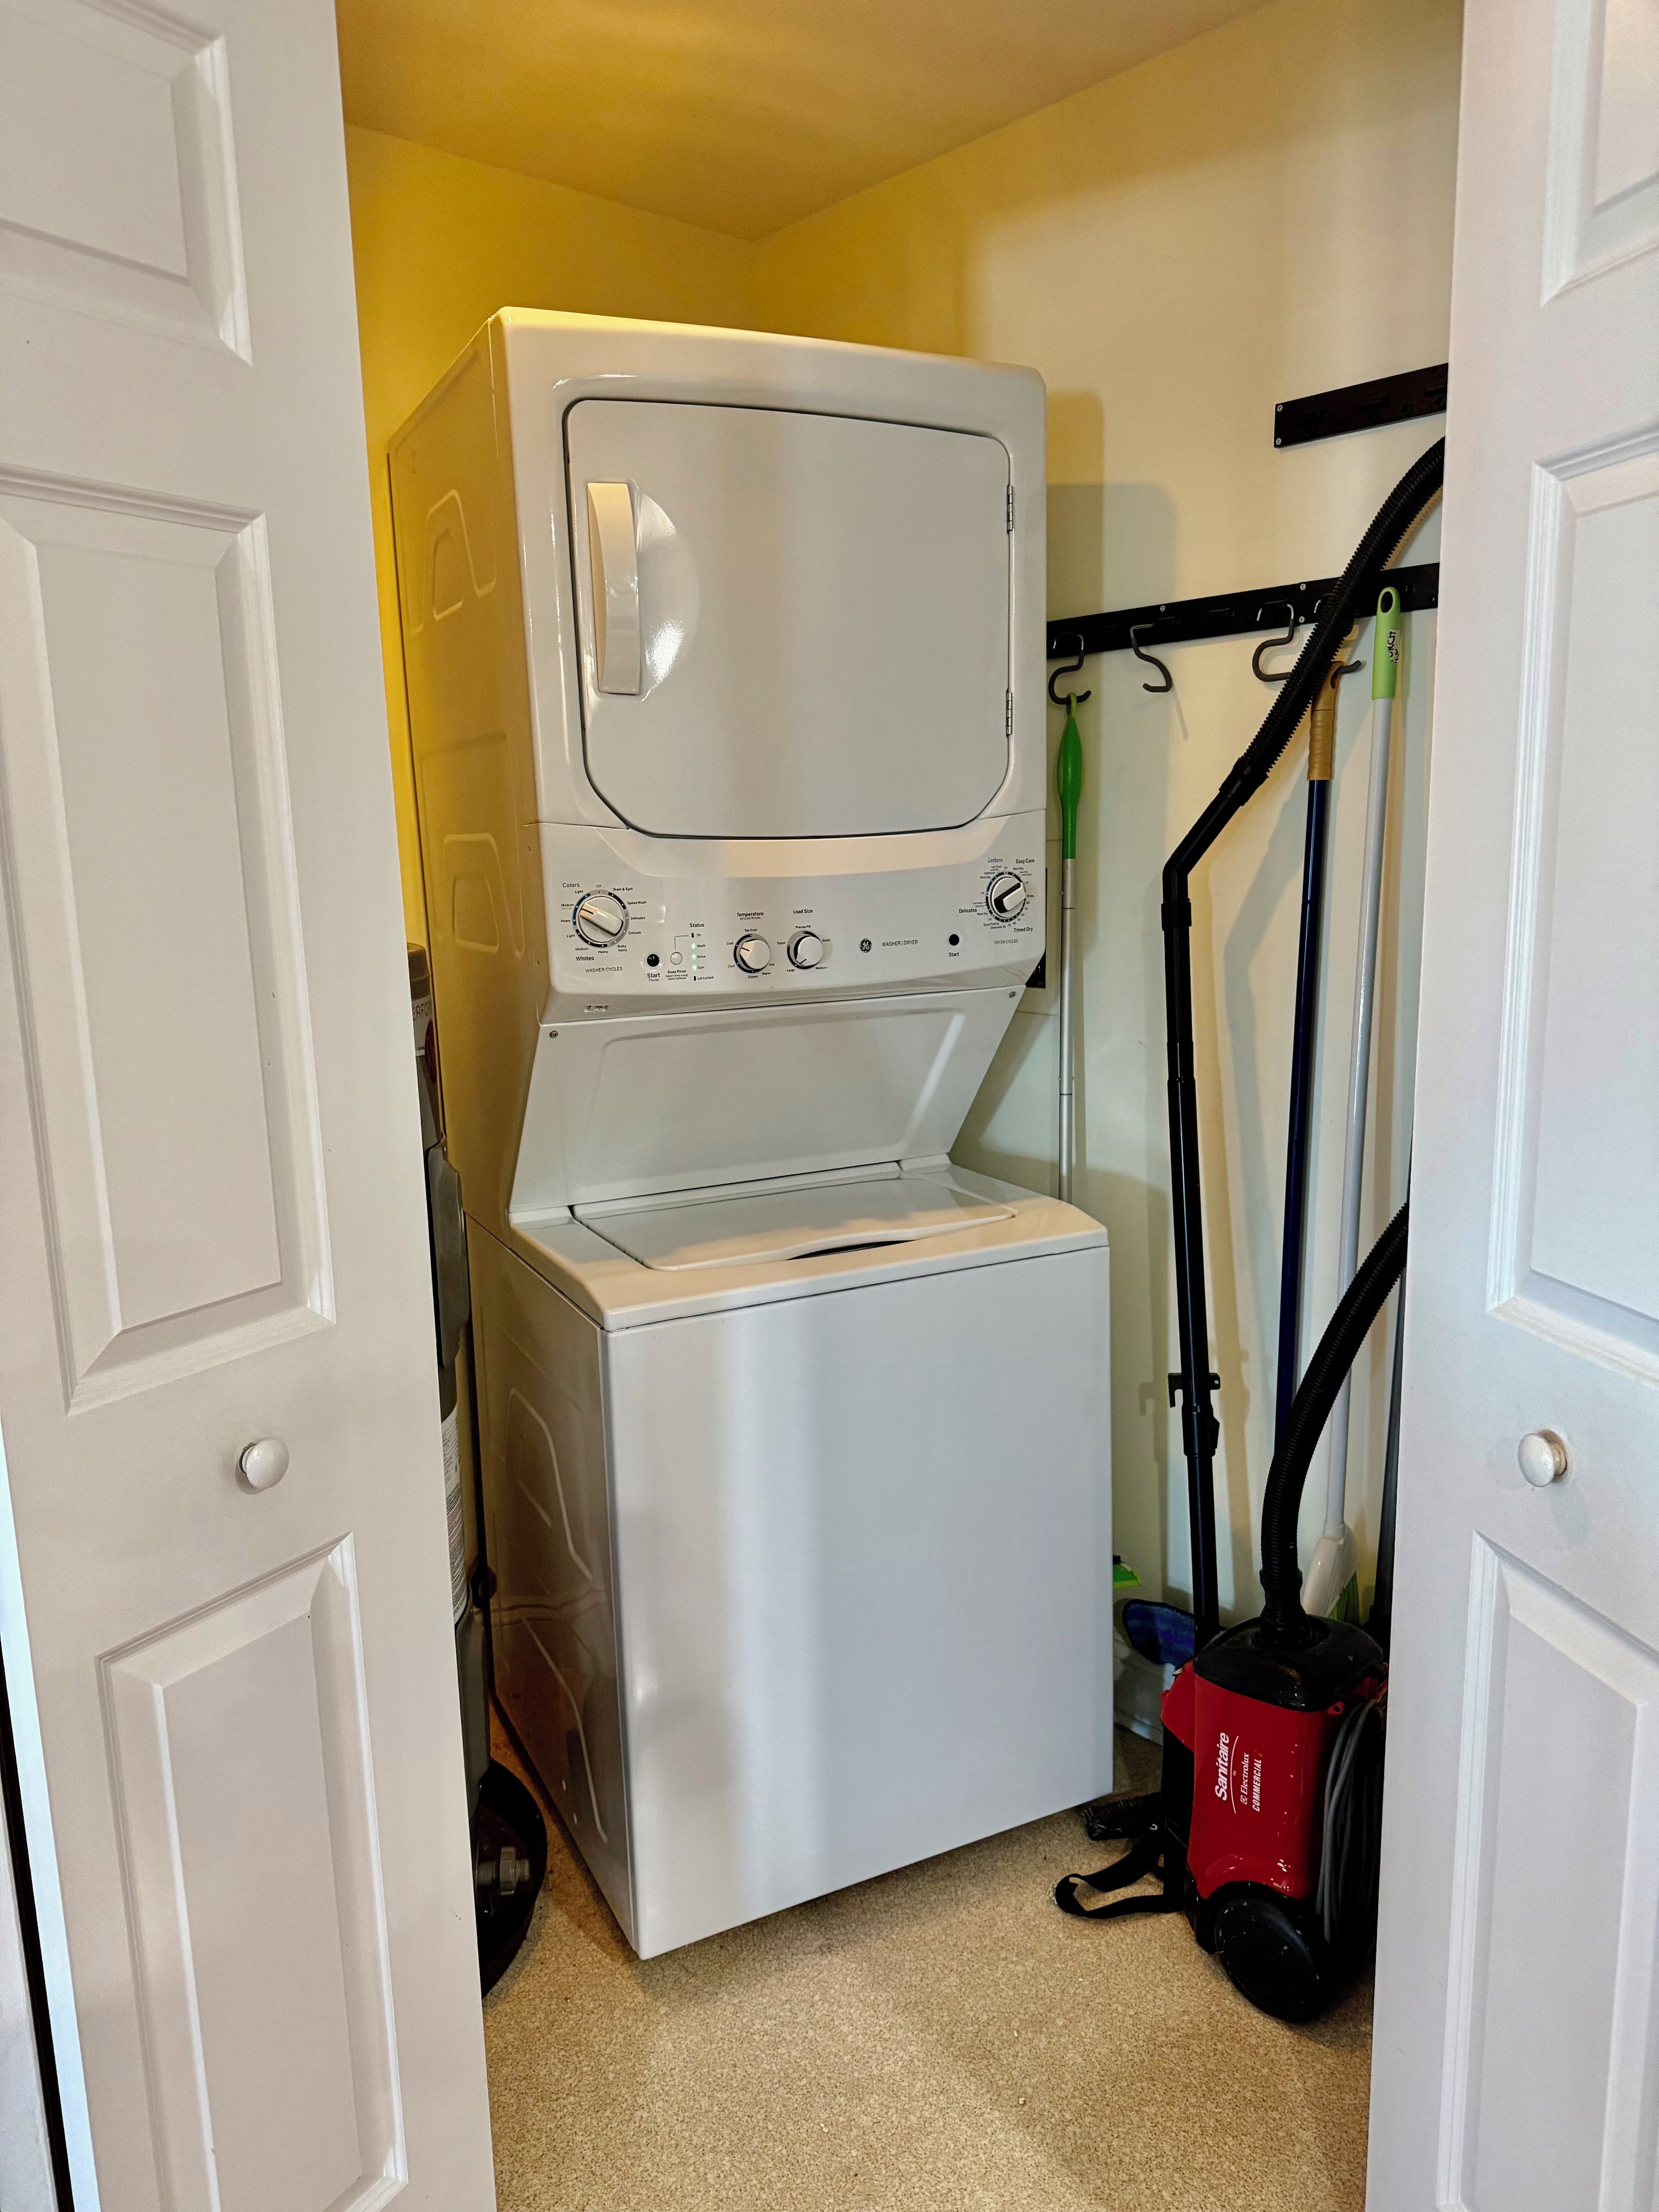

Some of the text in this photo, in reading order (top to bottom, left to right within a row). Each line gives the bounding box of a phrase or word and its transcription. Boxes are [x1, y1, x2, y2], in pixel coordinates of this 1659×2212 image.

[1215, 1733, 1229, 1801] Sanitaire
[1241, 1752, 1249, 1795] Electrolux
[1252, 1759, 1262, 1812] COMMERCIAL
